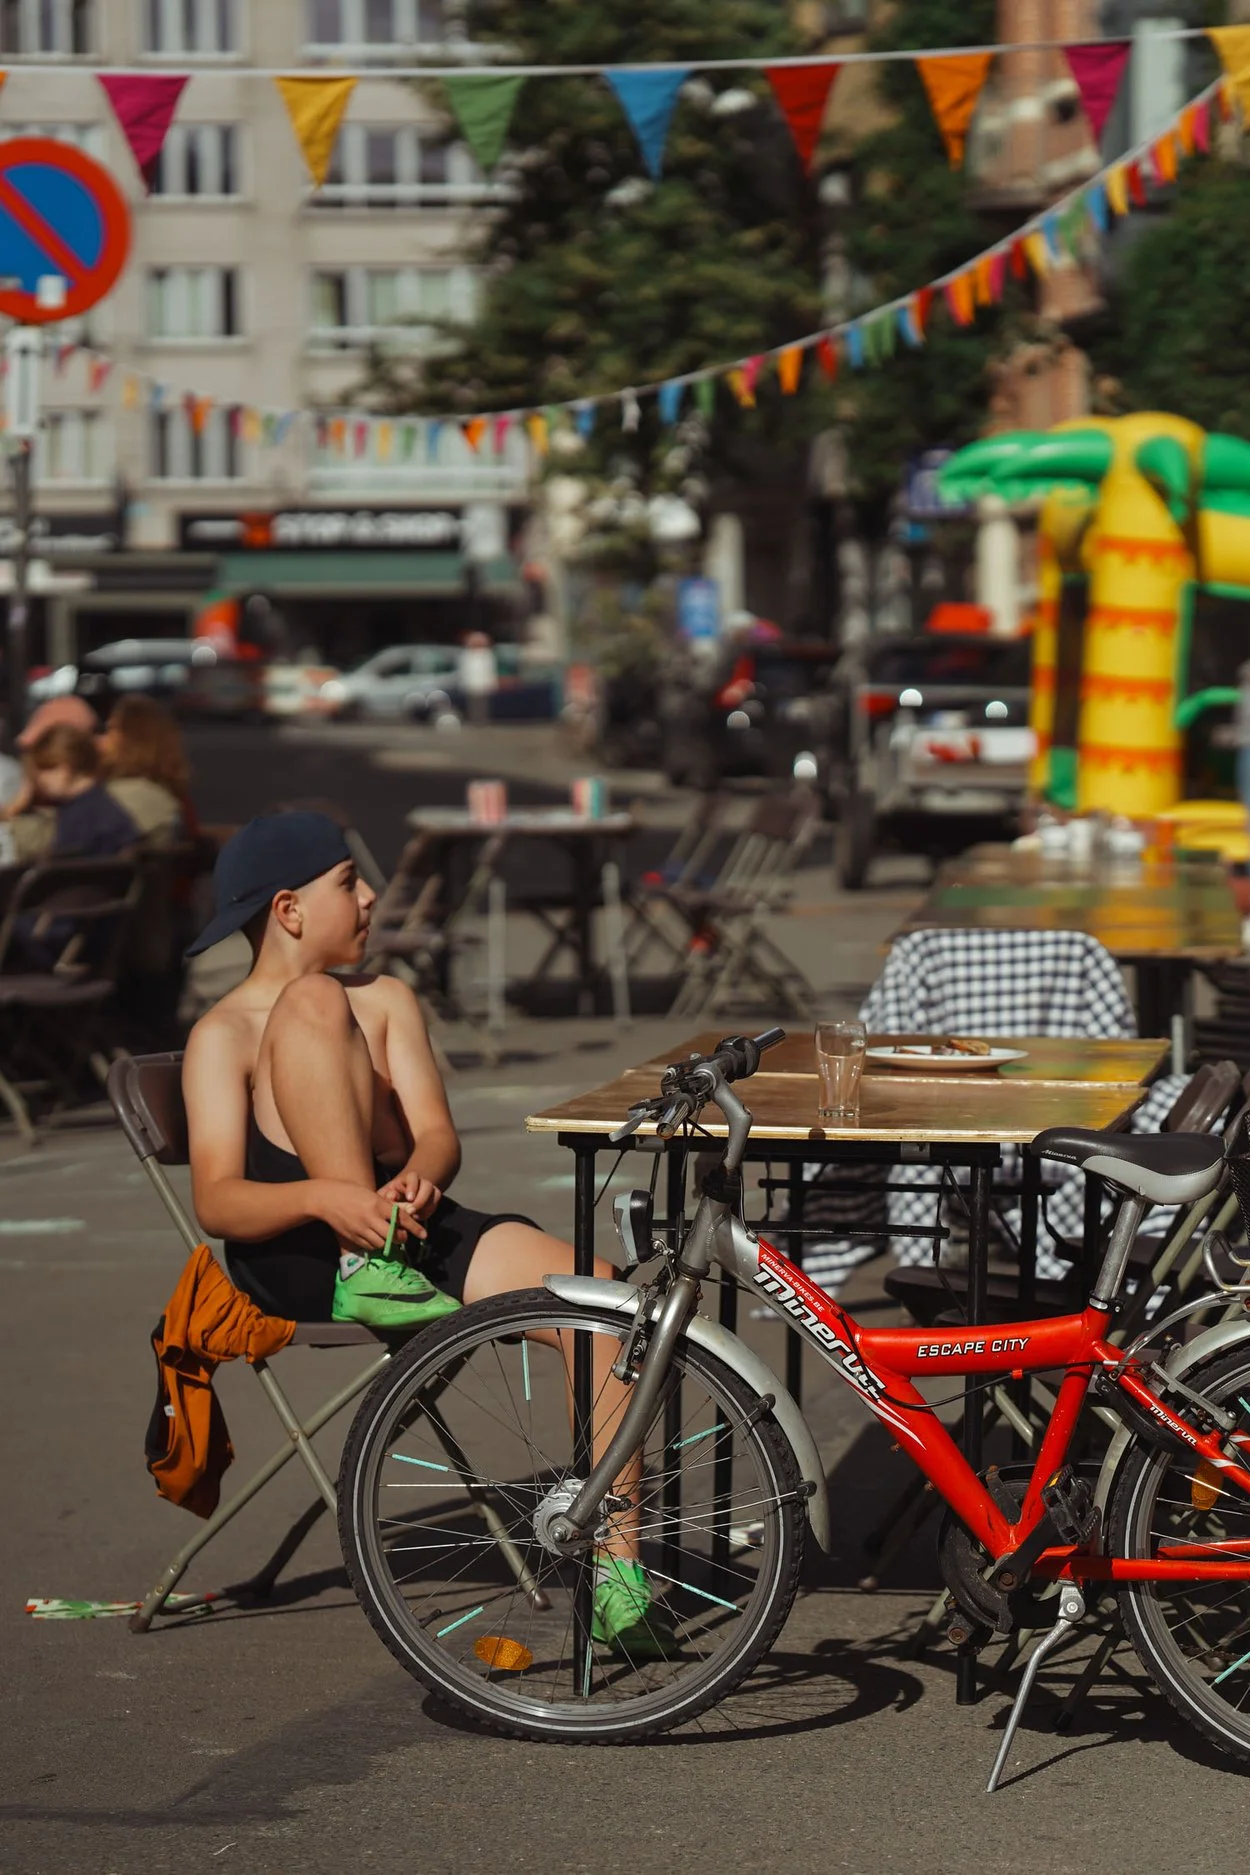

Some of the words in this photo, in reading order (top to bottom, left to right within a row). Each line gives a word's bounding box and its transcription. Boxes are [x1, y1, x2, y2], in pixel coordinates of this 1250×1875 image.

[760, 1253, 825, 1313] MINERVA-BIKES.BE
[917, 1340, 986, 1358] ESCAPE
[991, 1337, 1030, 1353] CITY
